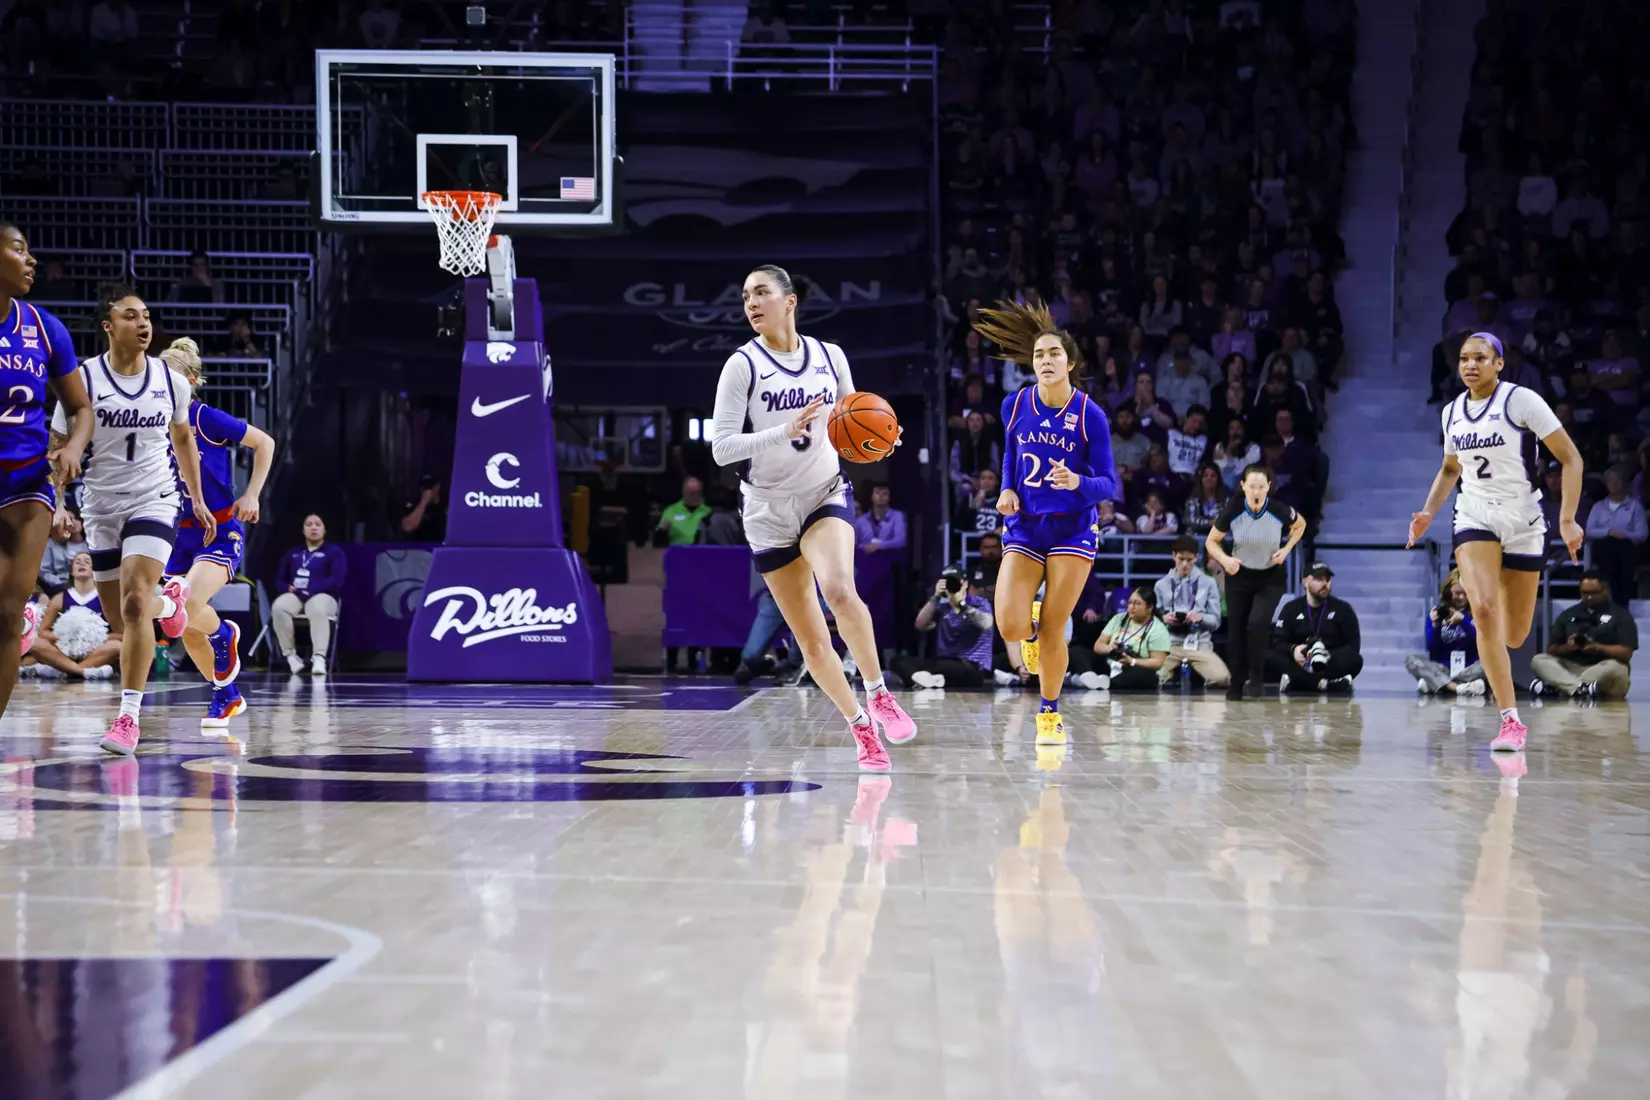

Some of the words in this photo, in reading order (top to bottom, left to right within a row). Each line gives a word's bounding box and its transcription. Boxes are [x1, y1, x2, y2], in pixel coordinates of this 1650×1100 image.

[623, 280, 882, 307] GLAAN
[761, 387, 834, 413] Wildcts
[97, 408, 166, 429] Wildcats
[125, 431, 138, 462] 1
[1016, 431, 1076, 452] KANSAS
[1452, 432, 1506, 451] Wildcats
[1473, 455, 1492, 479] 2
[975, 513, 996, 531] 23
[423, 585, 578, 642] Dillons
[520, 634, 541, 642] FOOD
[541, 634, 567, 643] STORES
